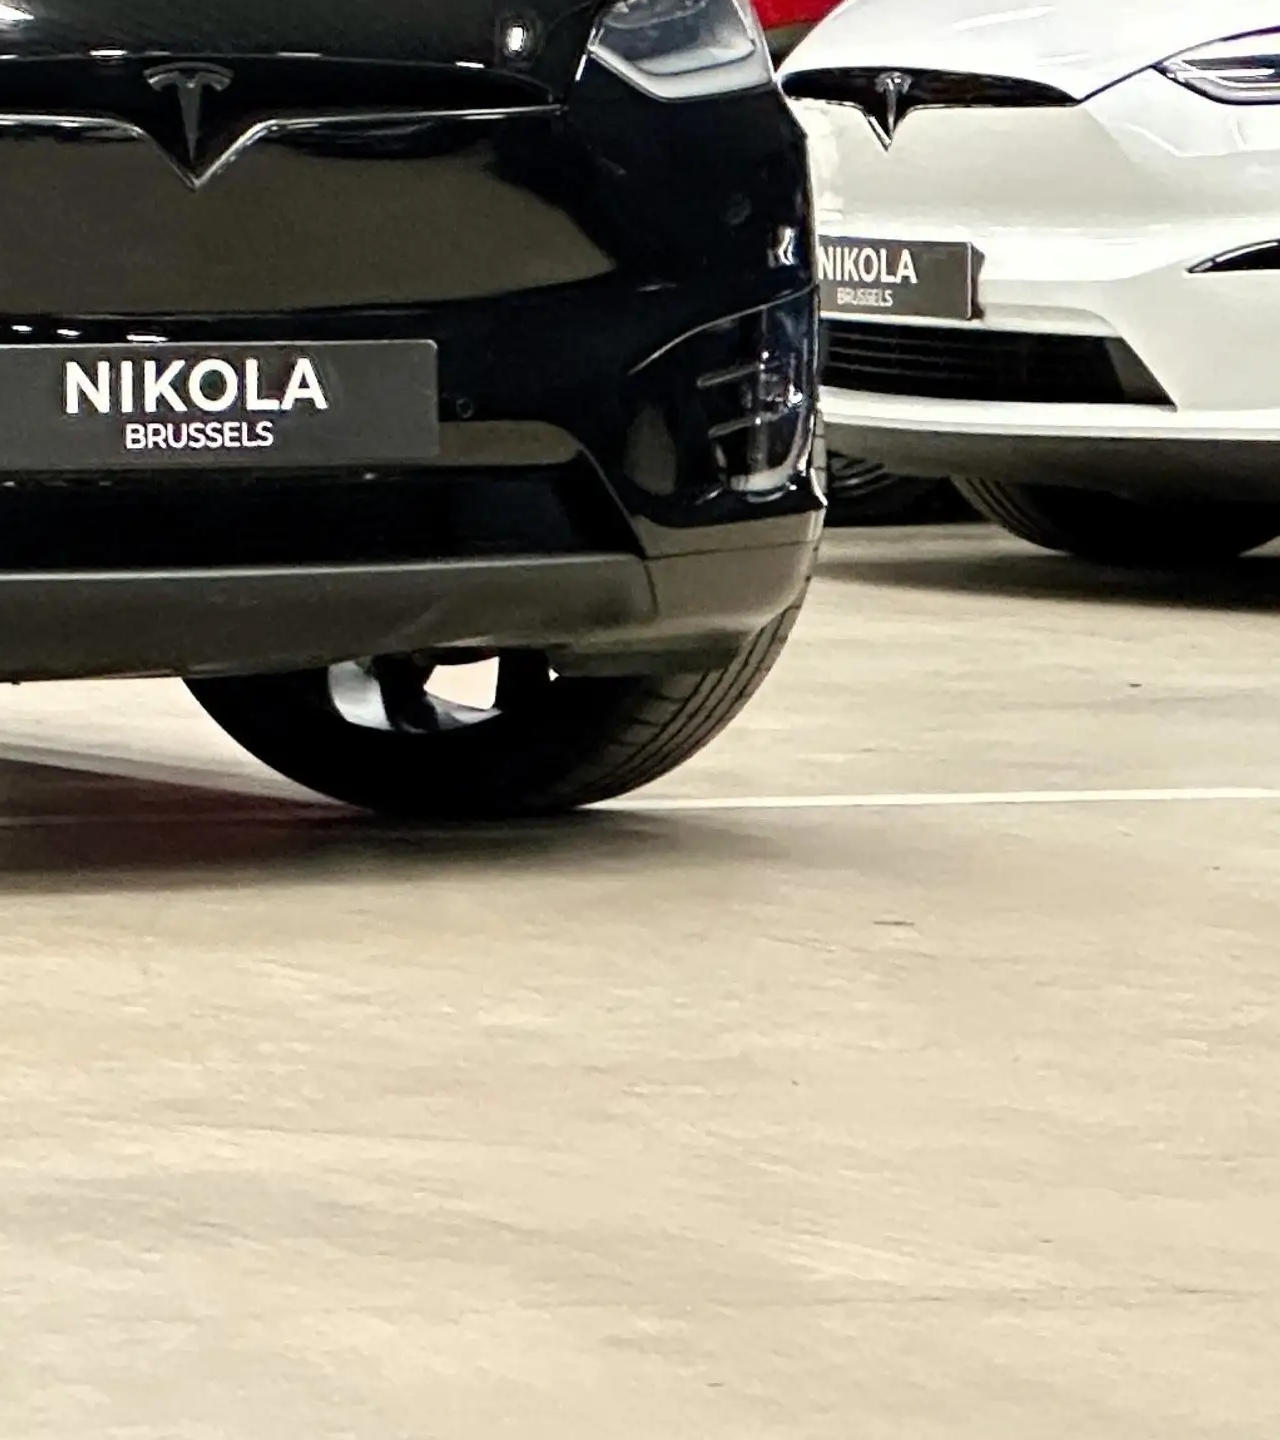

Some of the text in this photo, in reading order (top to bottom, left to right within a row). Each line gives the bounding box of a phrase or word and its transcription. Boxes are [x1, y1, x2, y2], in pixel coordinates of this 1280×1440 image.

[817, 245, 918, 284] NIKOLA
[65, 357, 328, 414] NIKOLA
[125, 420, 274, 449] BRUSSELS
